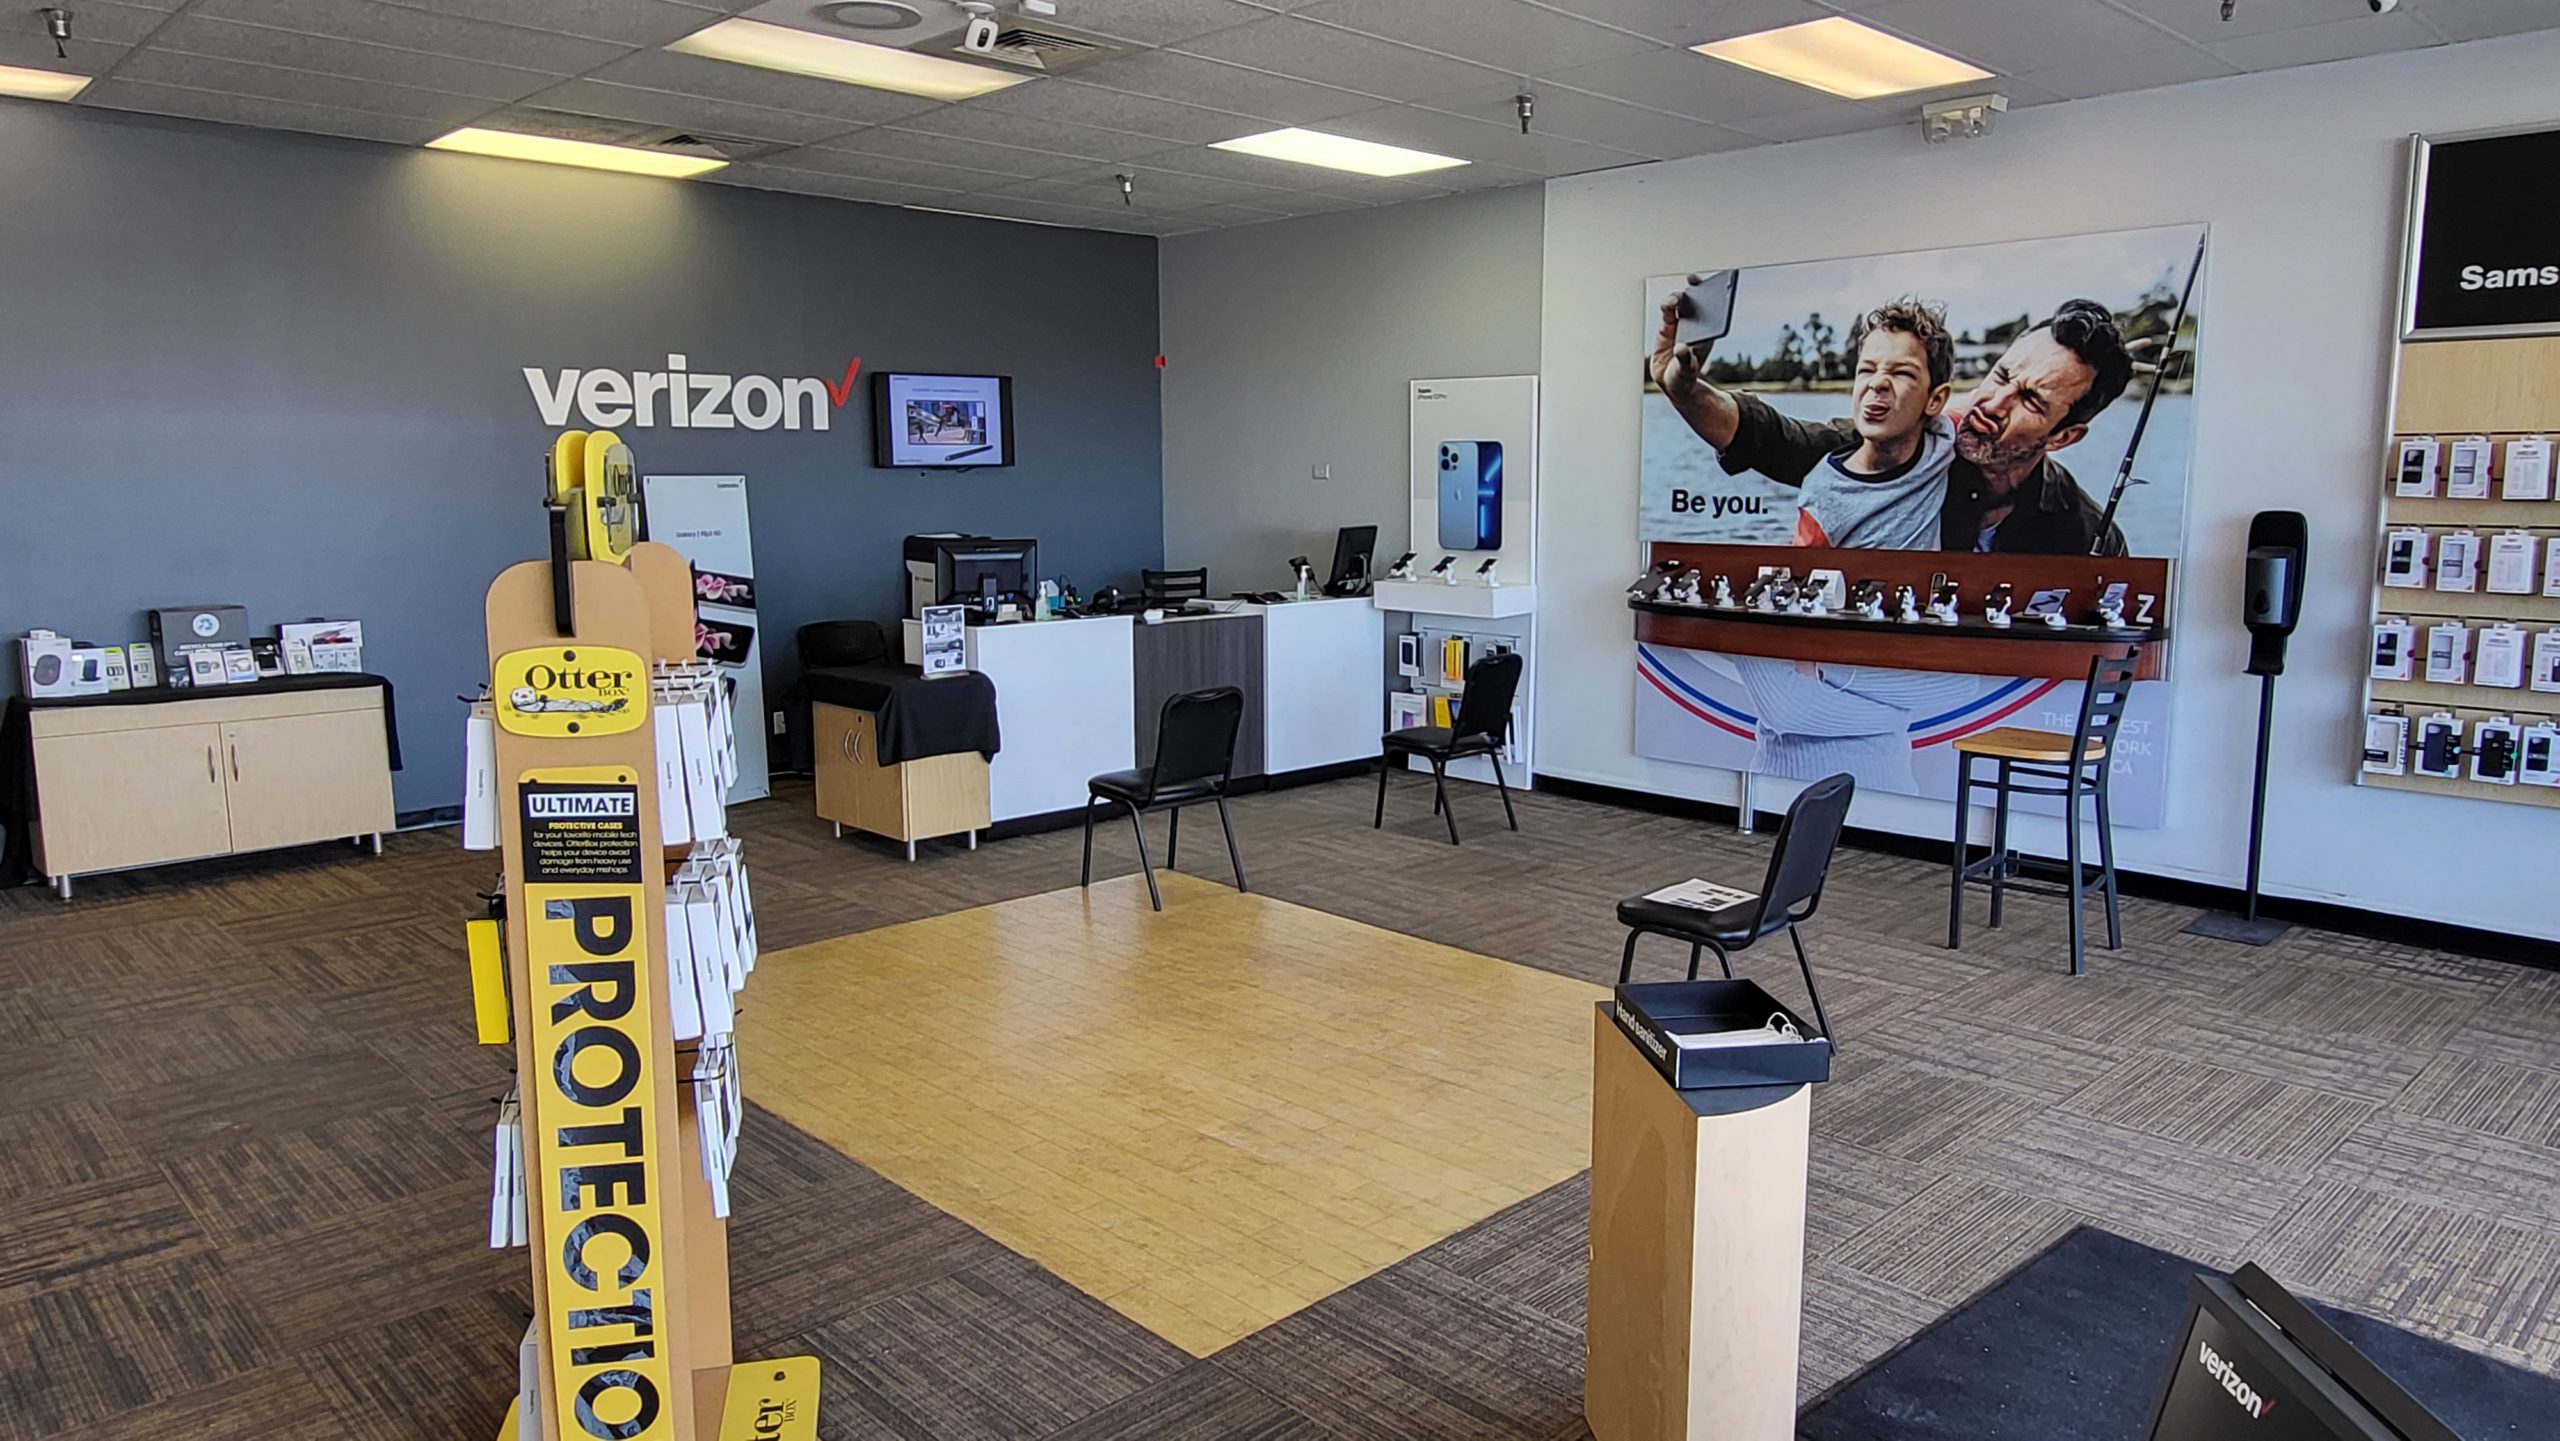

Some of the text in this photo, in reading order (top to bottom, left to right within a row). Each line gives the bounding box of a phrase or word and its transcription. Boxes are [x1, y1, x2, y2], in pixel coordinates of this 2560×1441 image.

[2460, 265, 2559, 290] Sams
[522, 353, 829, 430] verizon
[1671, 489, 1768, 519] Be you.
[2136, 594, 2155, 623] Z
[525, 665, 632, 691] Otter
[598, 688, 627, 697] BOX
[2042, 712, 2075, 728] THE
[532, 797, 631, 813] ULTIMATE
[548, 822, 623, 830] PROTECTIVE CASES
[1616, 999, 1667, 1062] Hand sanitizer
[545, 896, 660, 1440] PROTECTIO
[2199, 1341, 2262, 1419] verizon
